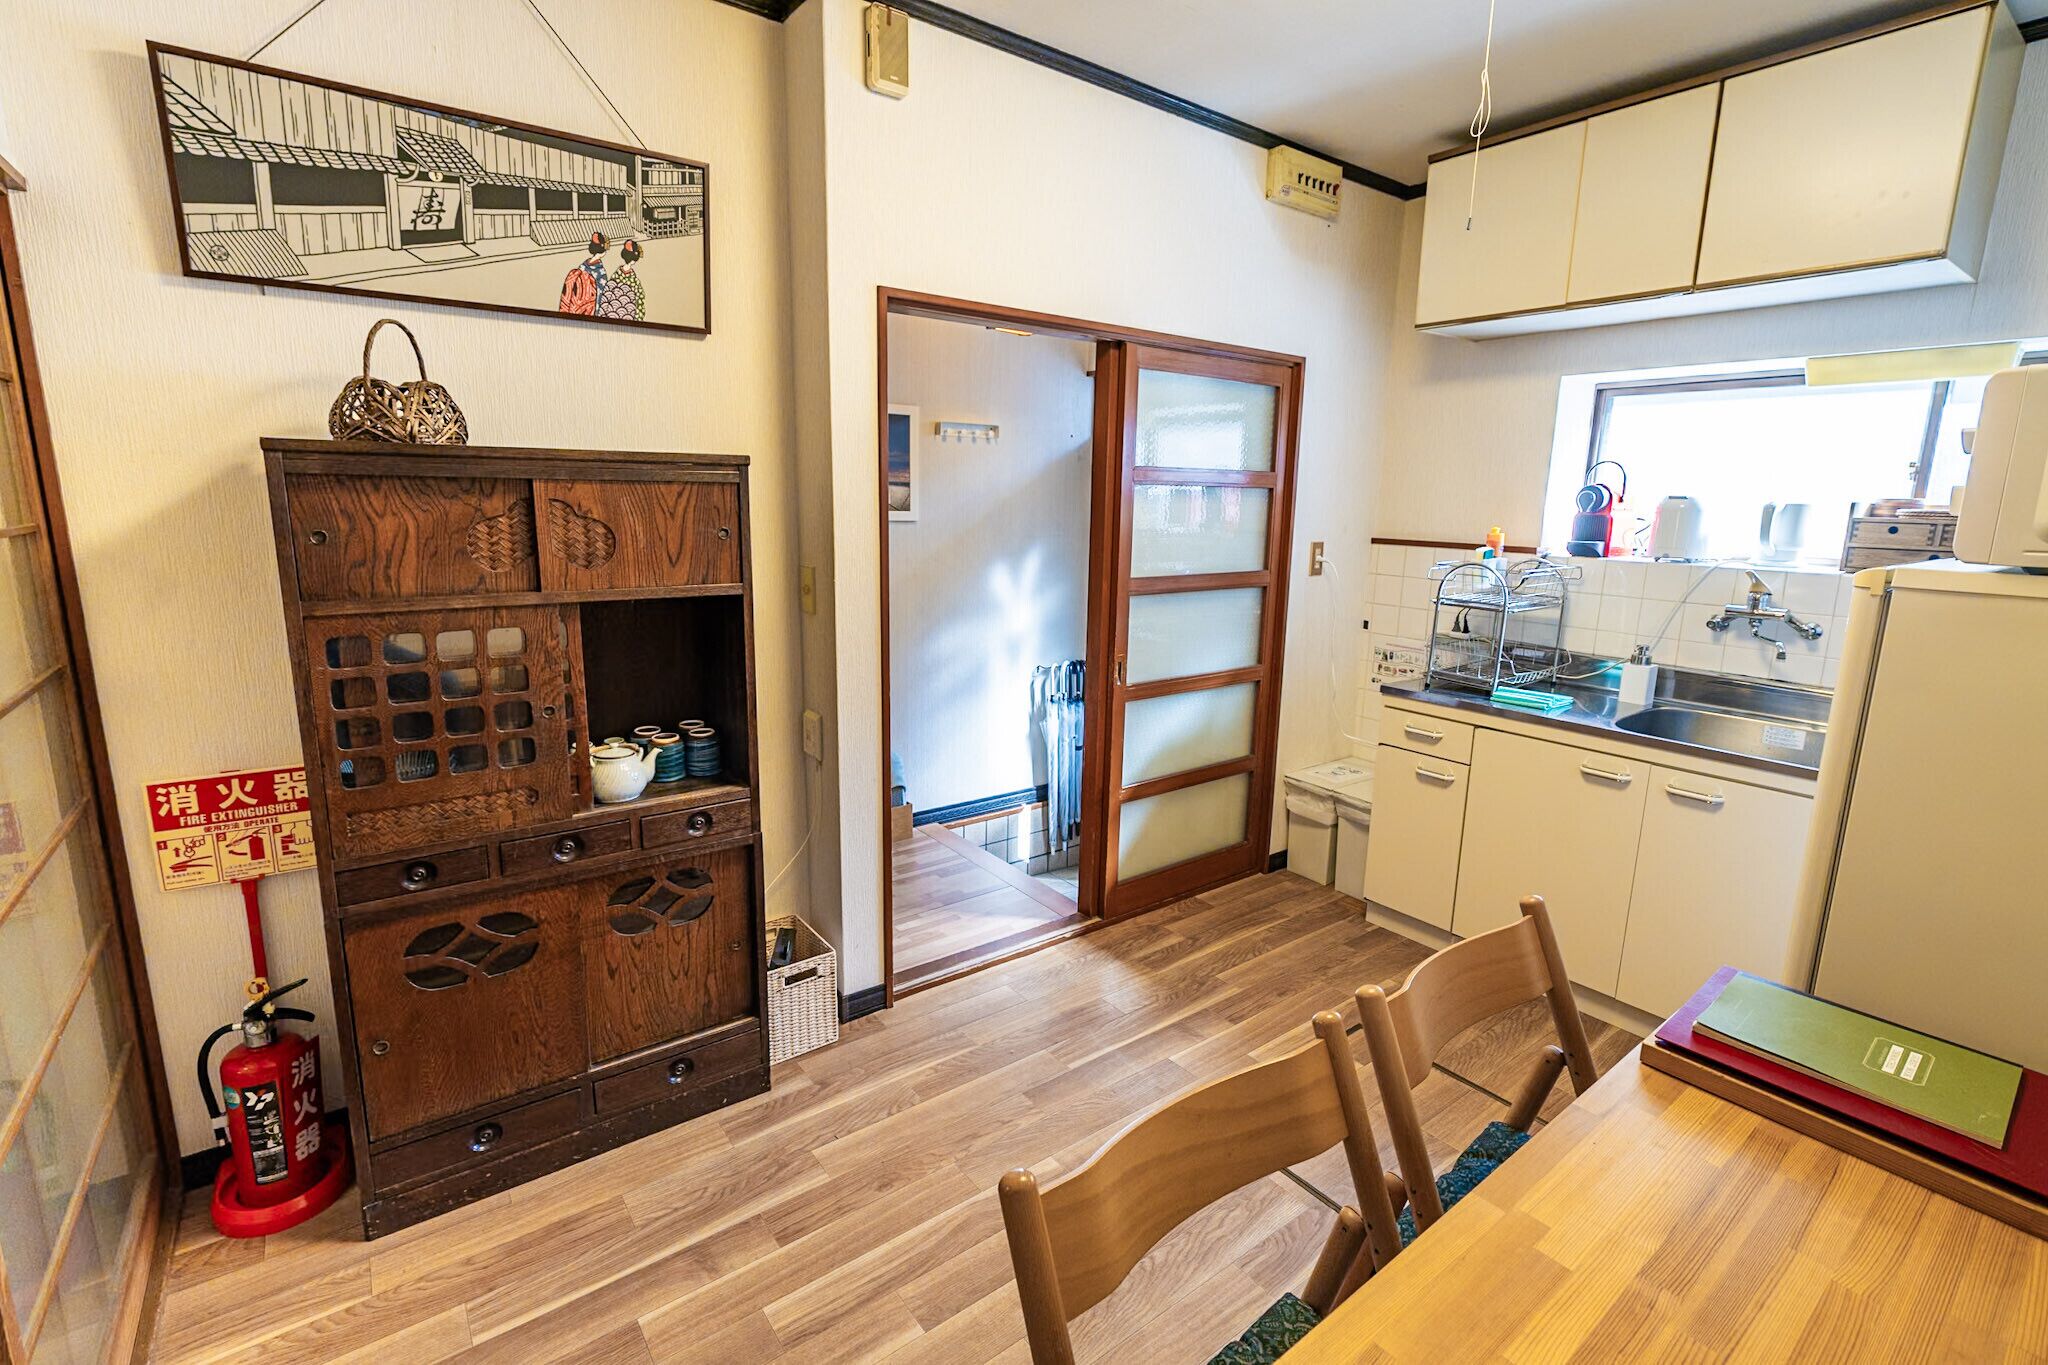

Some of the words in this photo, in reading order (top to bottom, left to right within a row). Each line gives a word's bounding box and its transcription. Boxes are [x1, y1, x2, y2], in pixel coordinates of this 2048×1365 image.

[155, 770, 309, 818] 消火器
[180, 813, 207, 827] FIRE
[211, 801, 299, 822] EXTINGUISHER
[244, 817, 279, 828] OPERATE
[291, 1050, 321, 1161] 消火器
